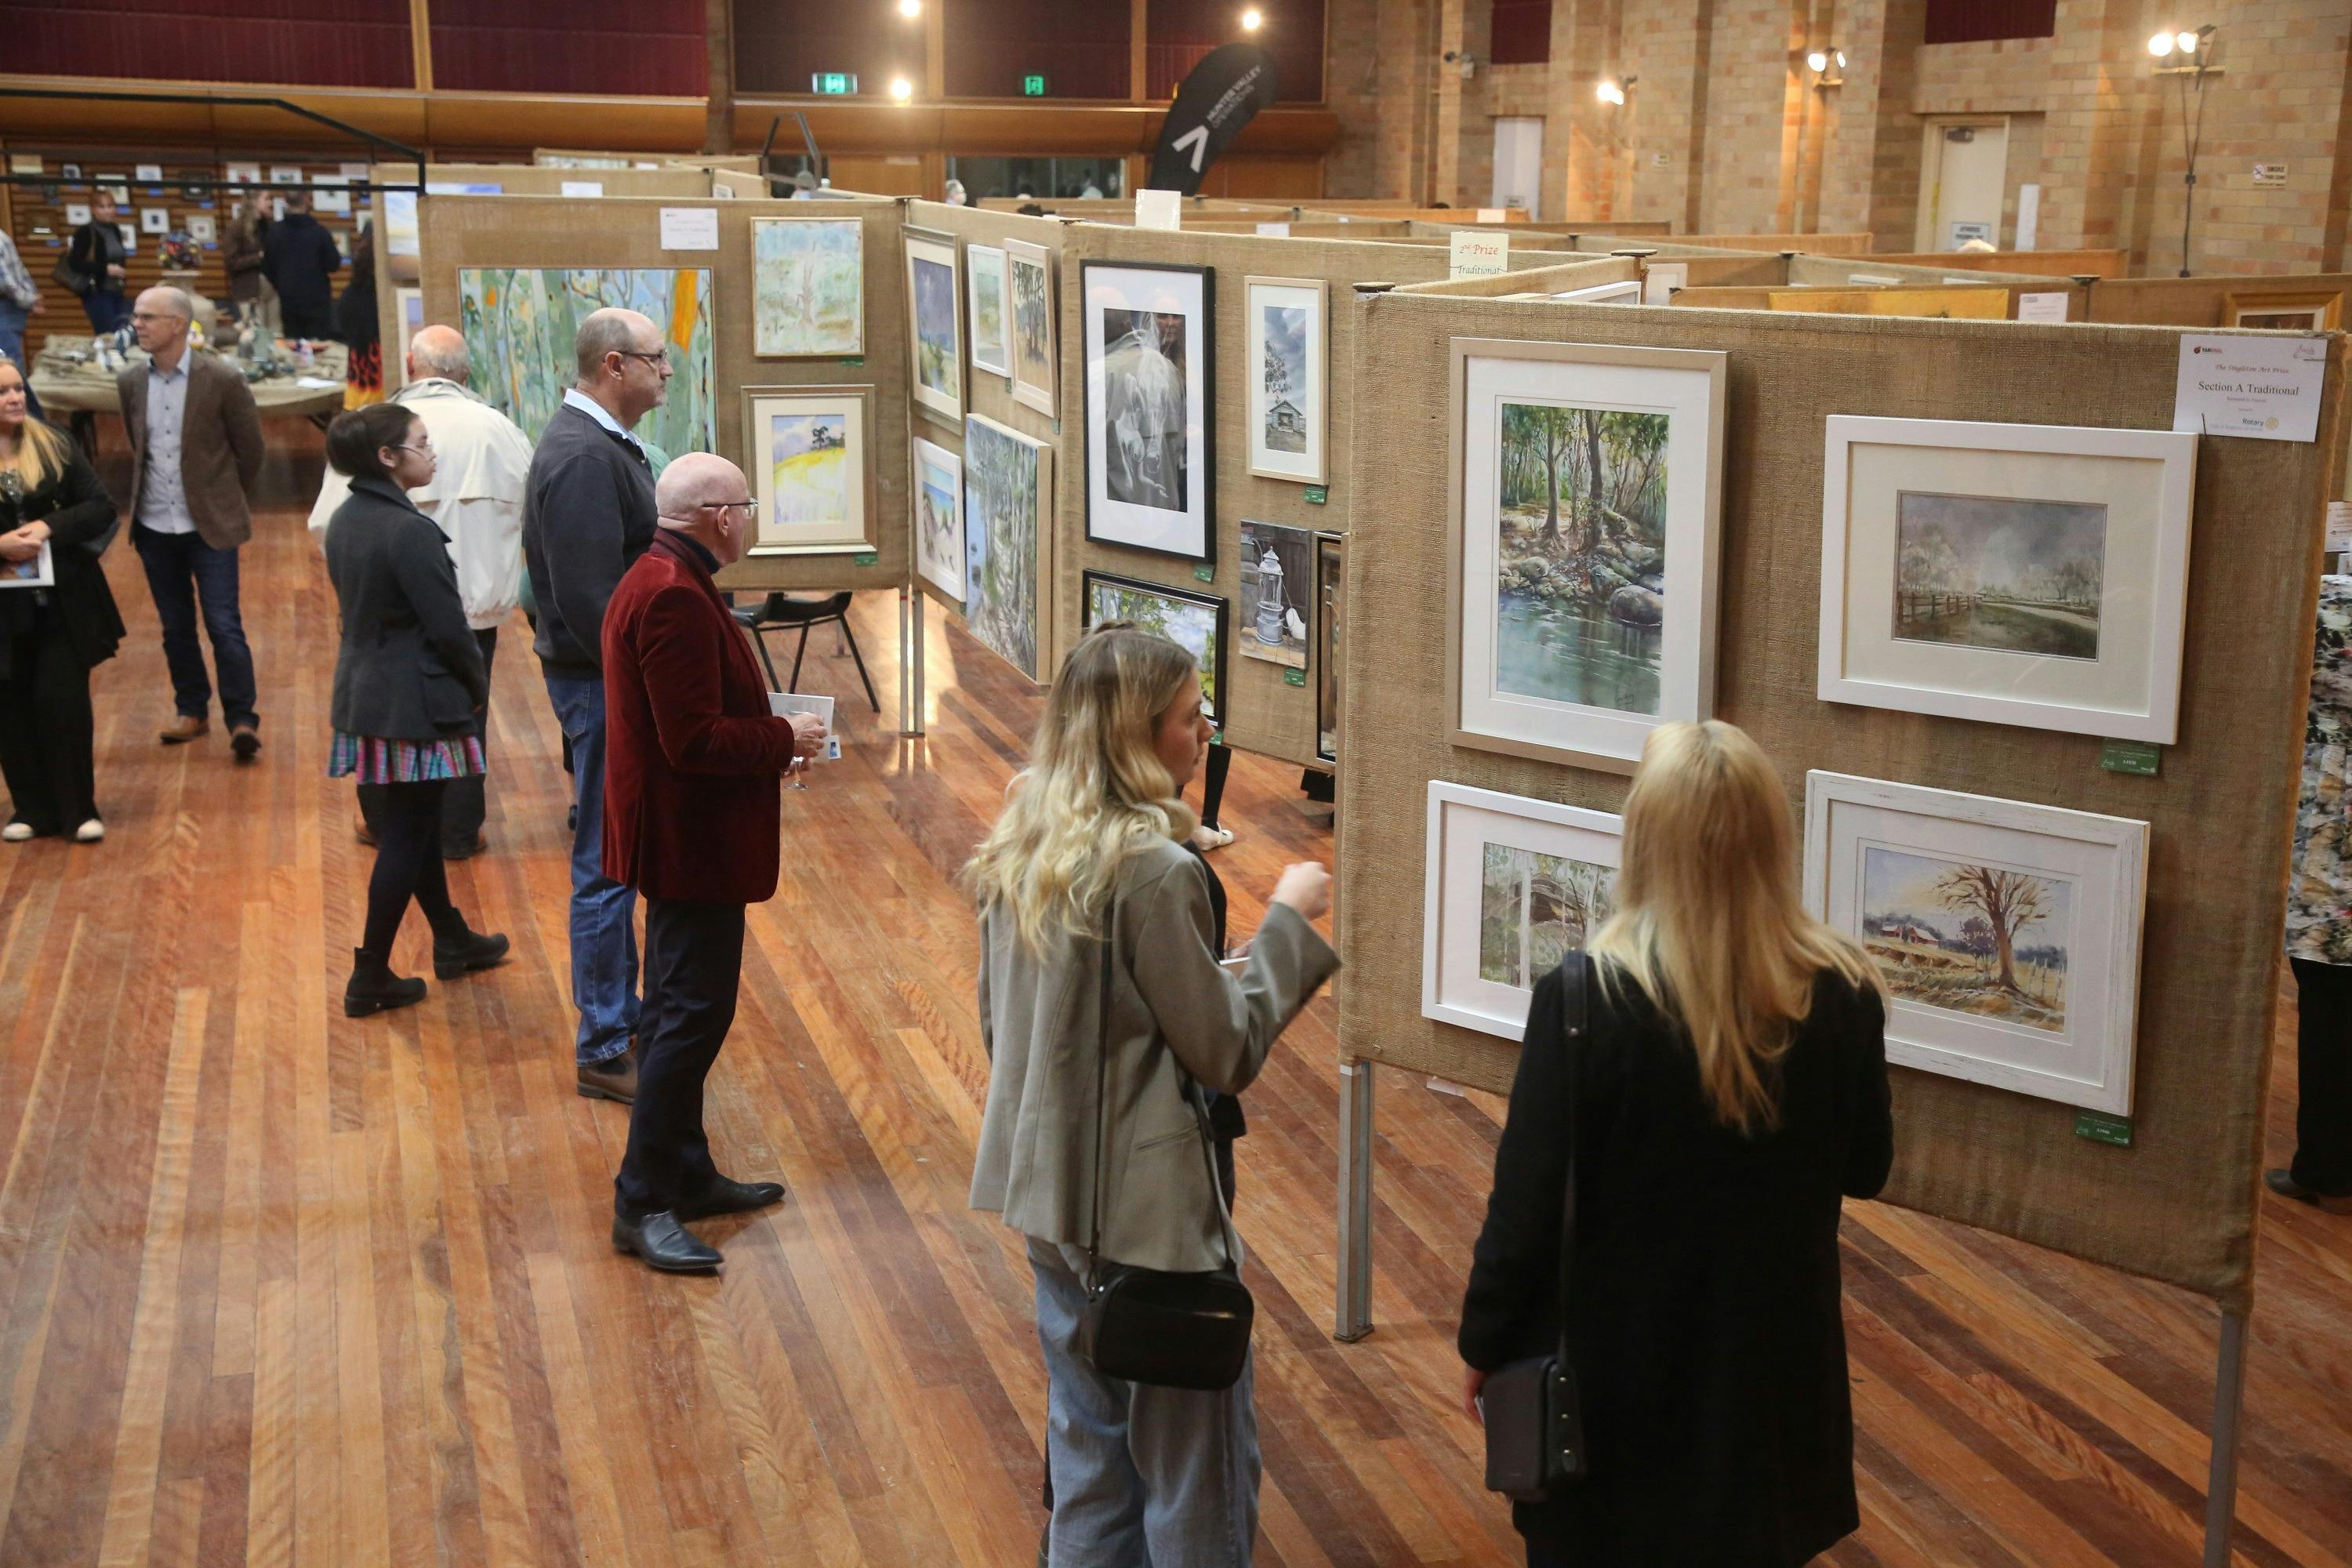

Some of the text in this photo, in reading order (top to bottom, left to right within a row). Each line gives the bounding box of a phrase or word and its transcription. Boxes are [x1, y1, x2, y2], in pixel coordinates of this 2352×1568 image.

[1474, 244, 1498, 255] Prize
[1458, 265, 1500, 274] Traditional
[2227, 365, 2257, 374] Singleton
[2198, 381, 2299, 396] Section A Traditional
[2242, 418, 2264, 427] Rotary
